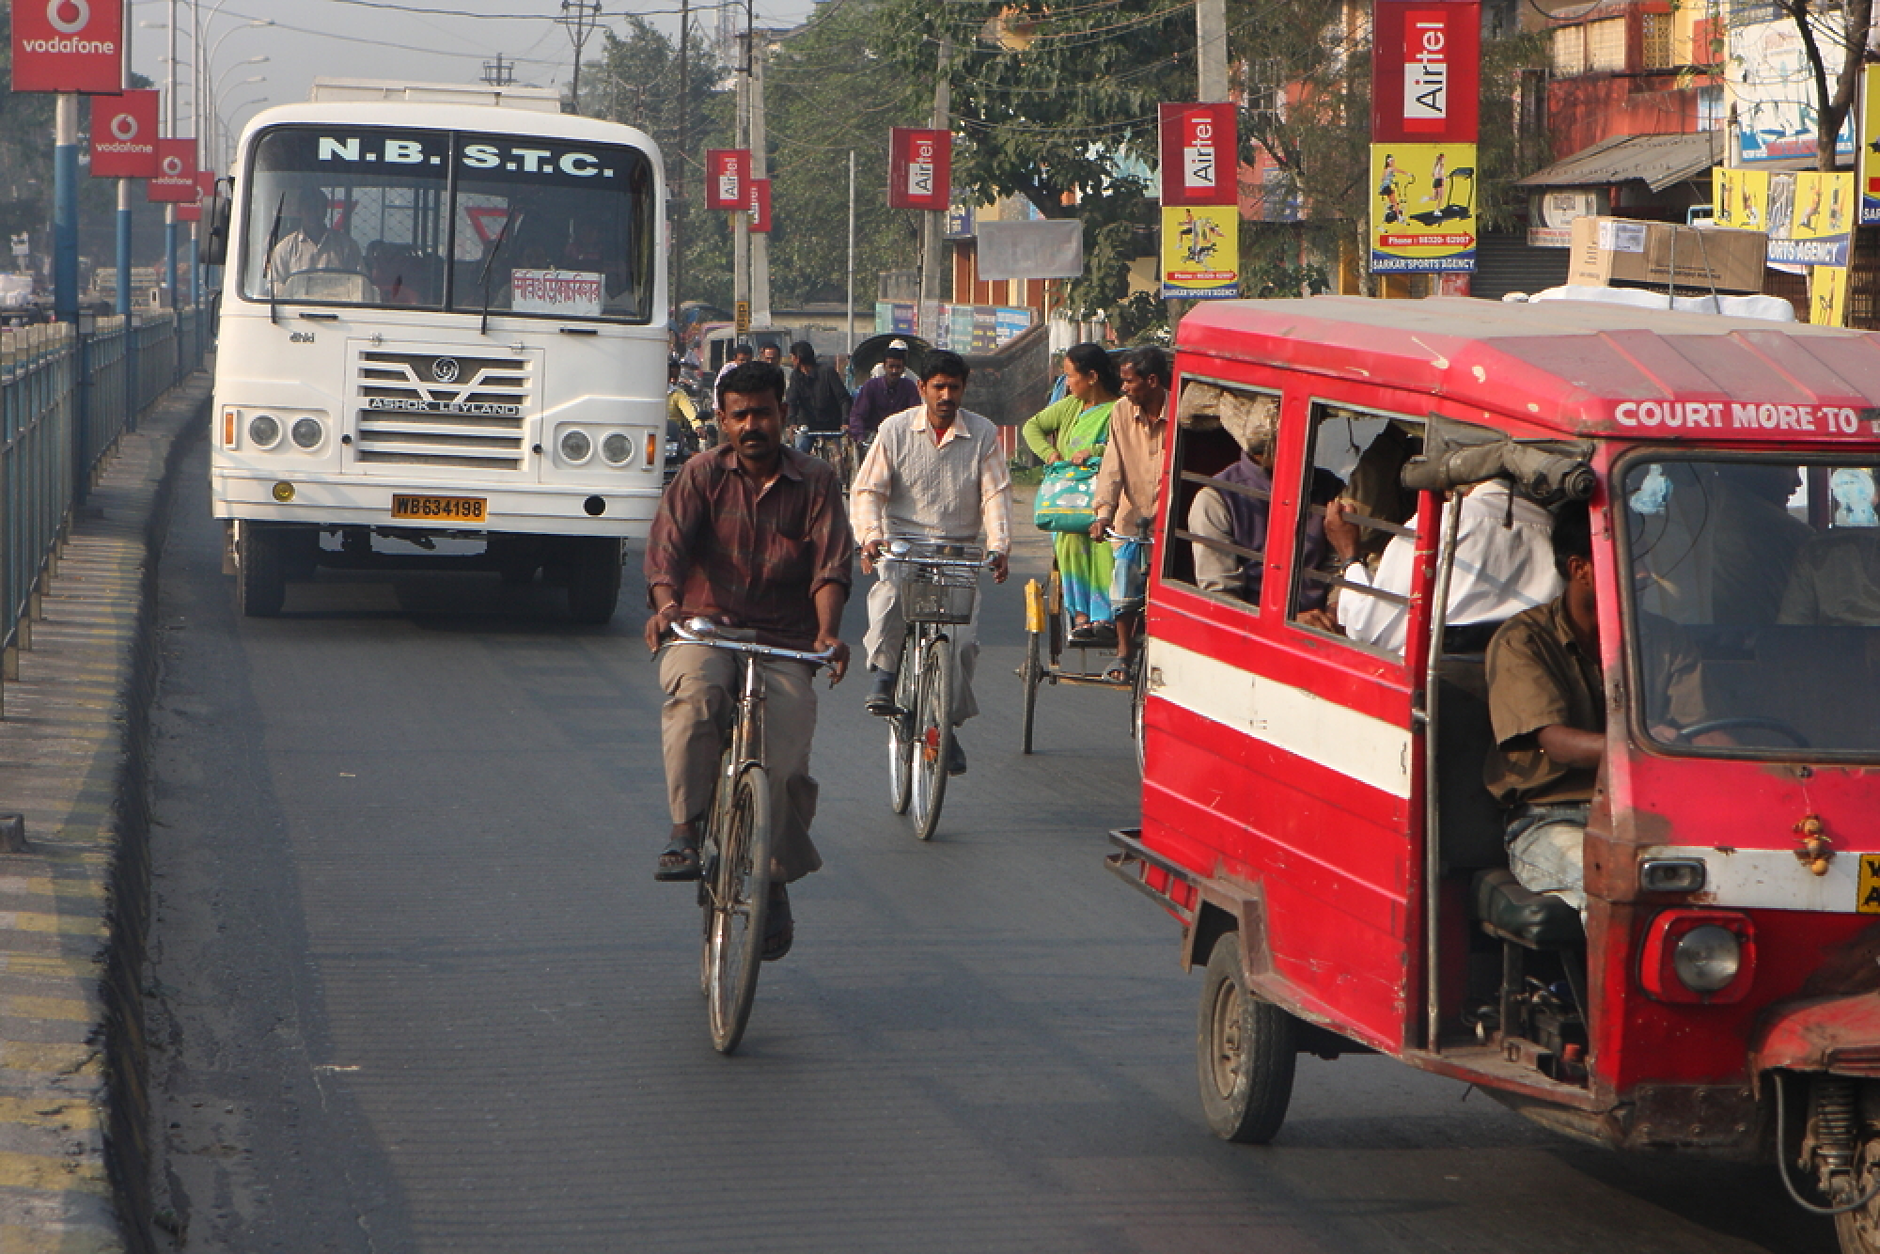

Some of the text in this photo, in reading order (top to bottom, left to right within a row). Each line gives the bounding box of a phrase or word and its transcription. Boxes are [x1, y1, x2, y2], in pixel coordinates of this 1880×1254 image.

[23, 37, 114, 54] vodafone
[1415, 22, 1444, 113] Airtel
[96, 141, 153, 154] vodafone
[318, 136, 614, 178] N.B. S.T.C.
[915, 140, 933, 192] Airtel
[1191, 118, 1213, 184] Airtel
[723, 157, 737, 198] Airtel
[371, 398, 518, 416] ASHOK LEYLAND
[1615, 401, 1726, 429] COURT
[1732, 402, 1816, 431] MORE
[1821, 406, 1859, 434] TO
